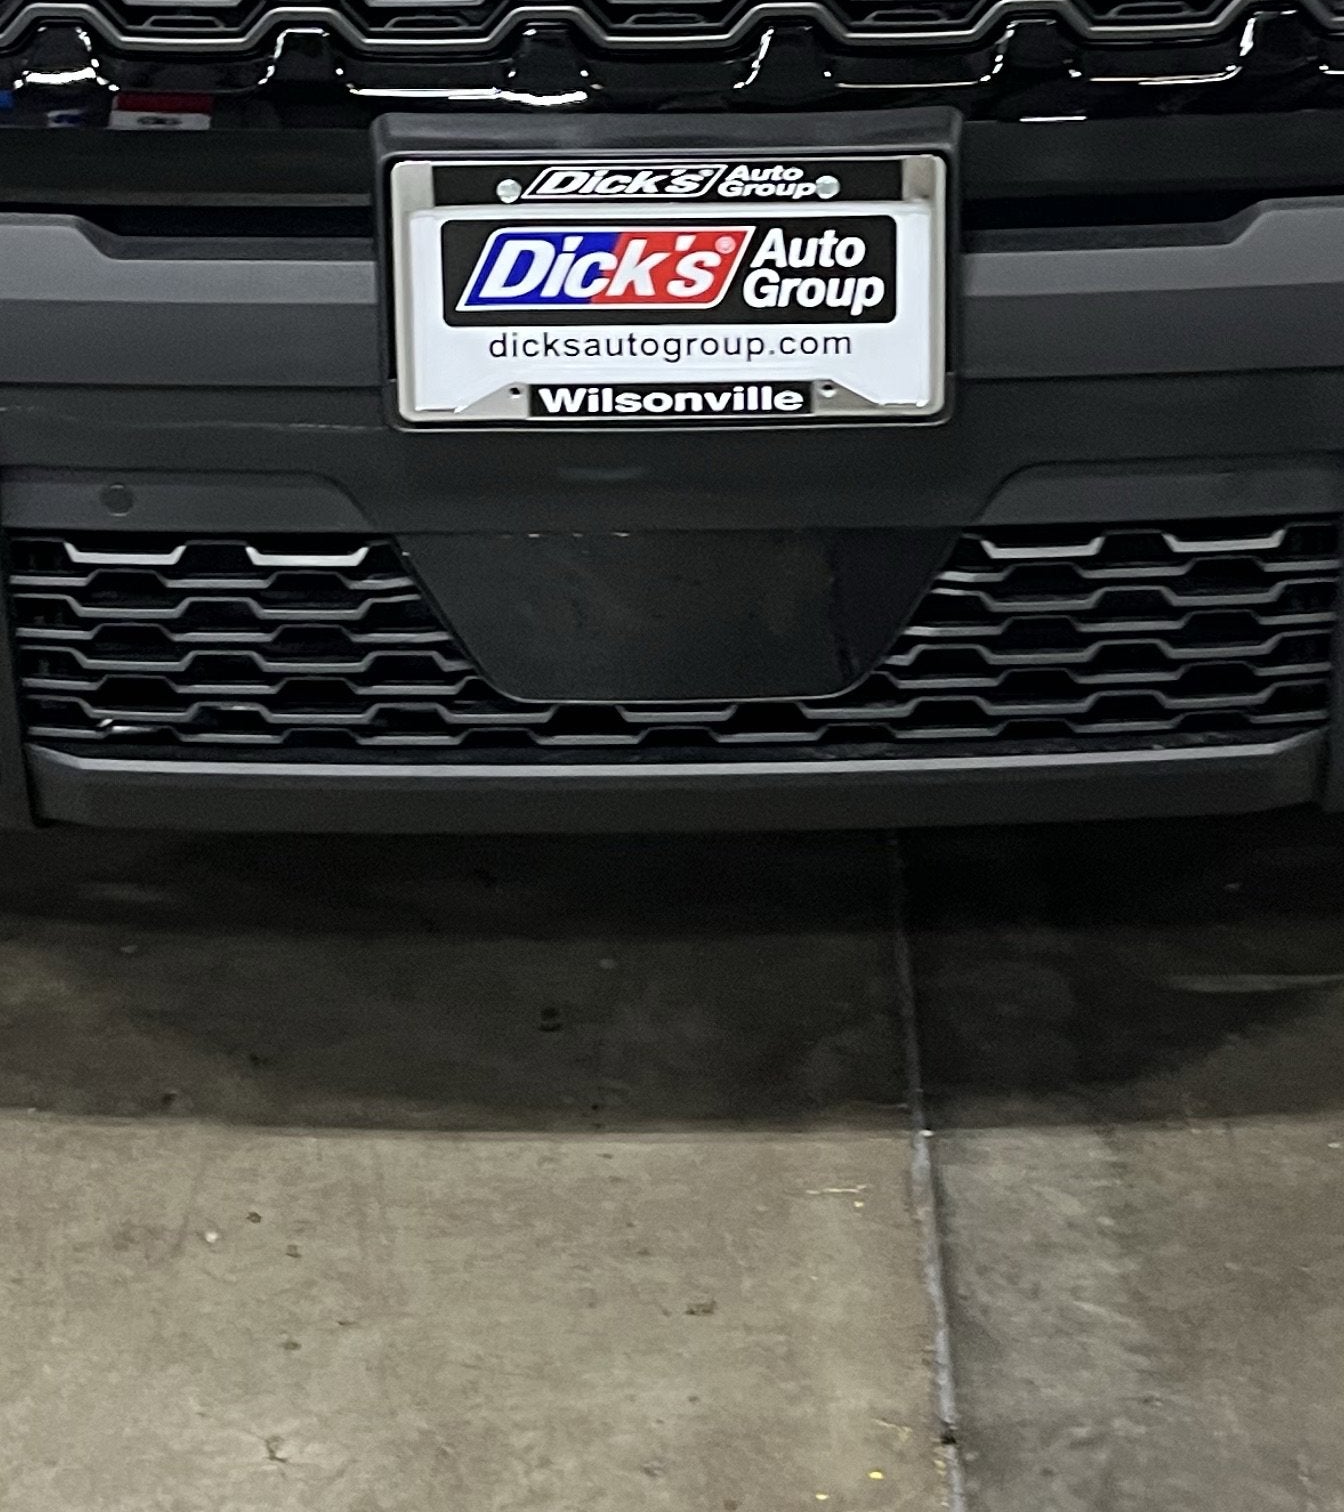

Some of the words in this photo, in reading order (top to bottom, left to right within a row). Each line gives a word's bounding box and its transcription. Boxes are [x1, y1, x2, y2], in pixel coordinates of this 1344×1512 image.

[535, 167, 701, 195] Dick's
[725, 164, 805, 181] Auto
[717, 179, 817, 199] Group
[750, 228, 866, 269] Auto
[477, 234, 721, 299] Dick's
[743, 269, 885, 316] Group
[489, 332, 852, 363] dicksautogroup.com
[537, 385, 804, 414] Wilsonville
